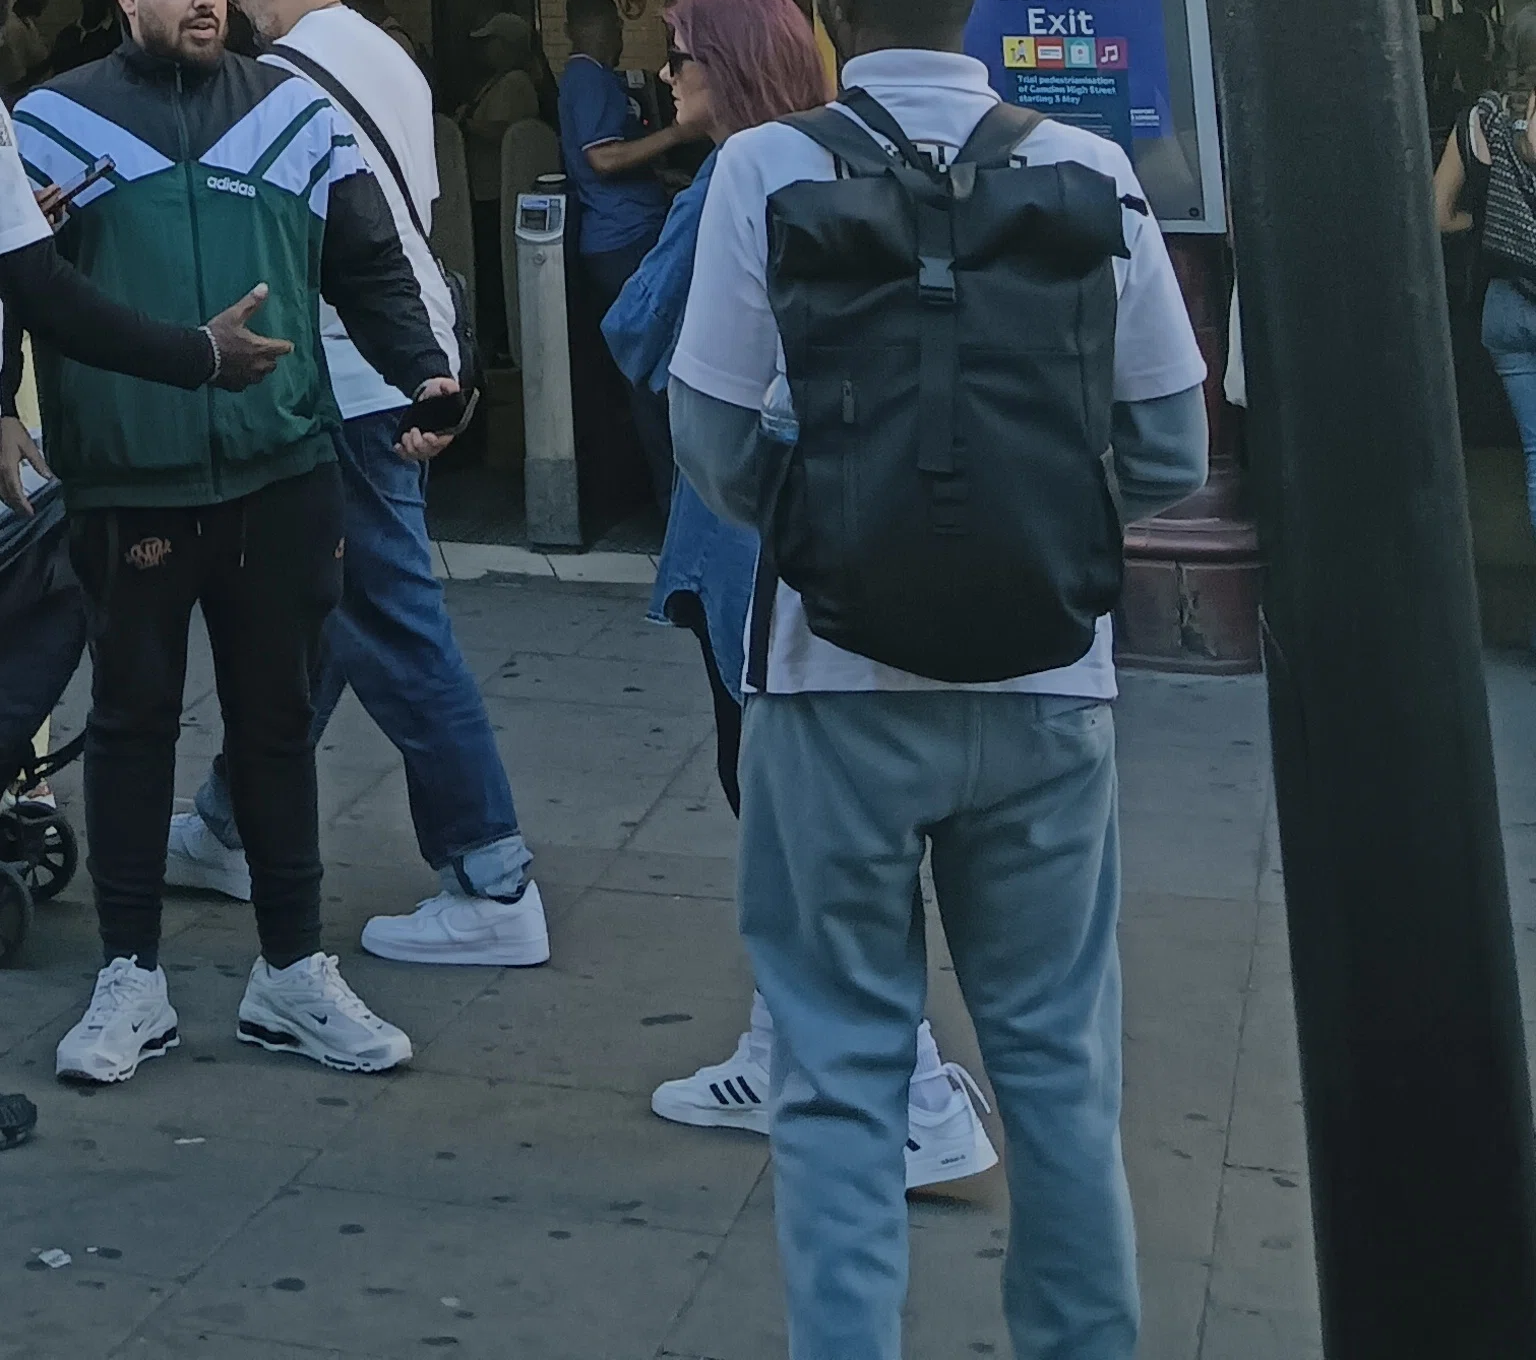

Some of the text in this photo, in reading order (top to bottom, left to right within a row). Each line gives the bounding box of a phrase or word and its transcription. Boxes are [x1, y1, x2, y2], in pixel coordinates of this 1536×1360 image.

[1028, 8, 1095, 36] Exit
[1017, 74, 1038, 83] Trial
[1018, 84, 1116, 95] of Camden High Street
[1019, 94, 1054, 105] starting
[206, 175, 257, 198] adidas
